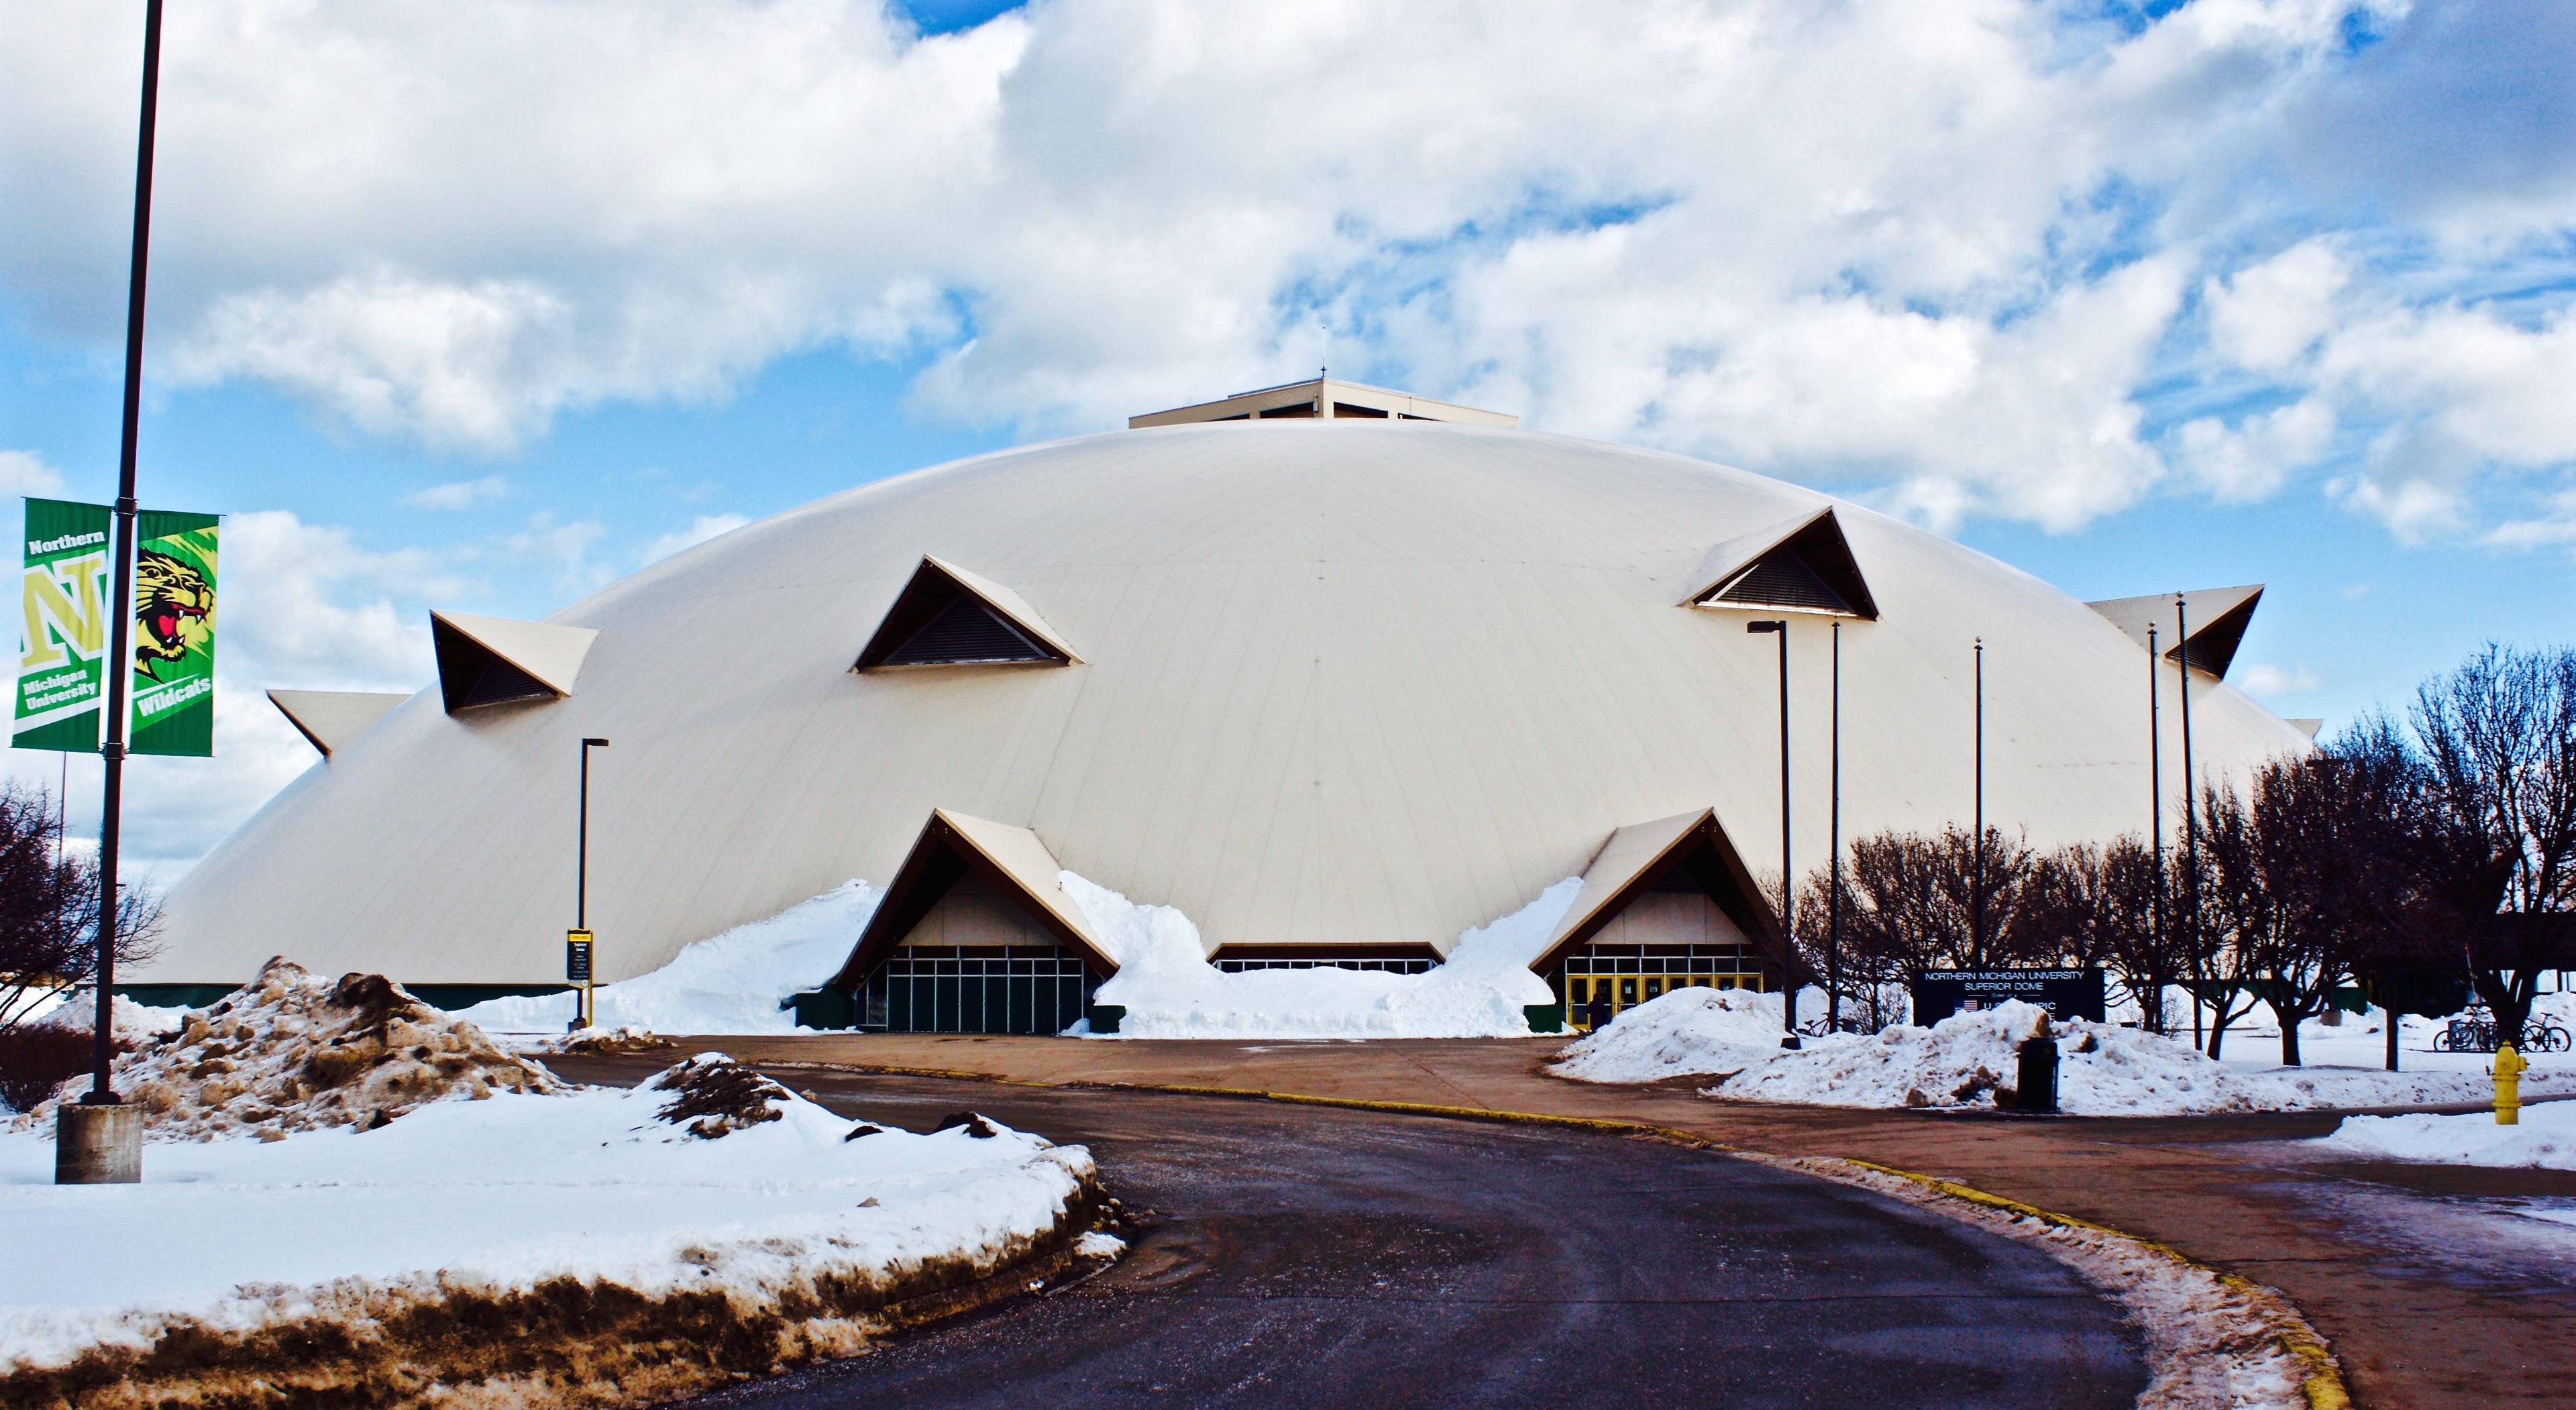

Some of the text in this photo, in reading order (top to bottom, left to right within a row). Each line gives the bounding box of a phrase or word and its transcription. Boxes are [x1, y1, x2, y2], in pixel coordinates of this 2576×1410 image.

[28, 531, 105, 555] Northern
[20, 551, 108, 673] N
[23, 669, 87, 696] Michigan
[25, 682, 96, 710] University
[138, 677, 211, 717] Wildcats
[1925, 971, 2085, 980] NORTHERN MICHIGAN UNIVERSITY
[1964, 982, 2044, 991] SUPERIOR DOME
